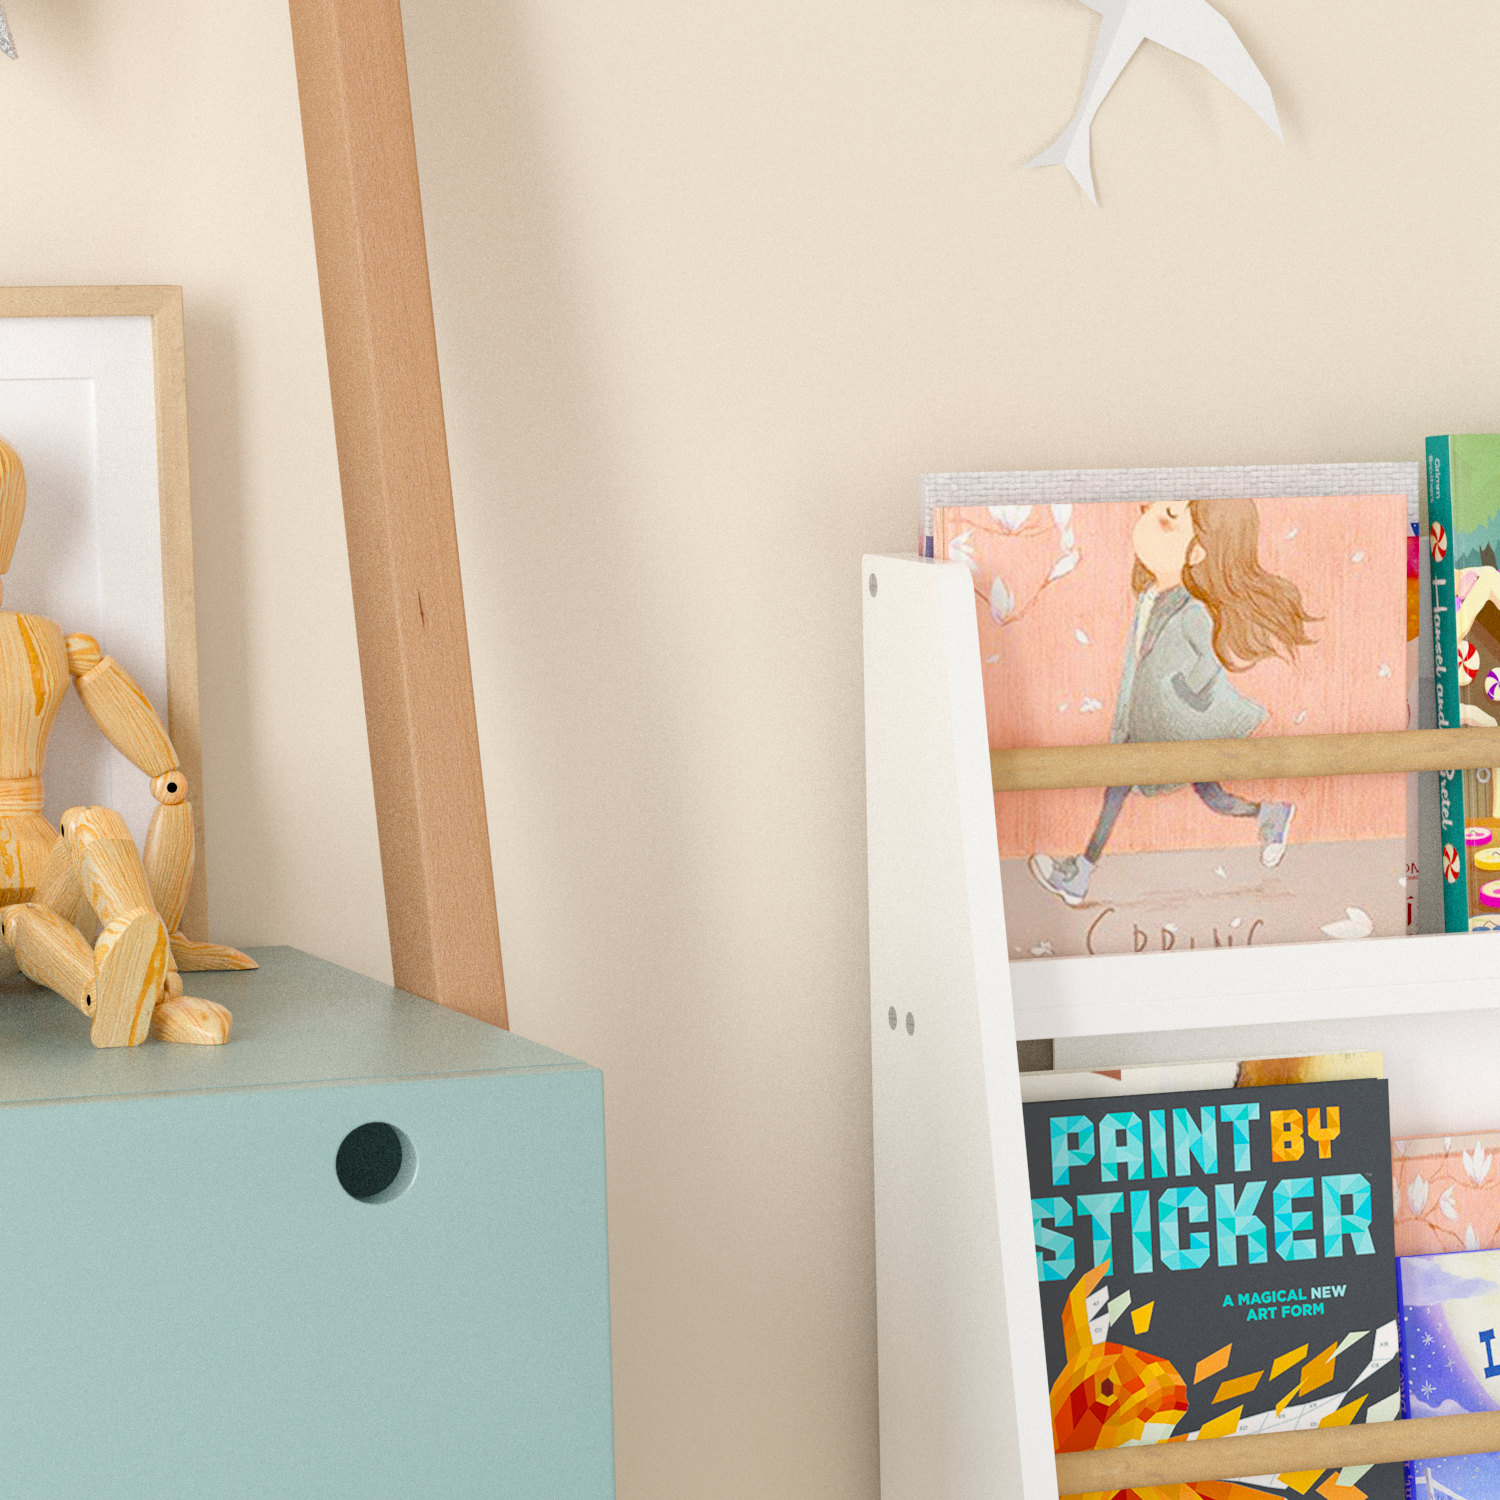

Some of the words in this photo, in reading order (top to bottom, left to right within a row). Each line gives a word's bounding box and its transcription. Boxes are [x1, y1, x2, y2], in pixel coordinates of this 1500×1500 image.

[1432, 577, 1449, 678] Hansel
[1049, 1102, 1260, 1186] PAINT
[1270, 1106, 1341, 1163] BY
[1031, 1173, 1376, 1282] STICKER
[1222, 1294, 1234, 1307] A
[1238, 1288, 1307, 1306] MAGICAL
[1310, 1284, 1347, 1300] NEW
[1246, 1307, 1278, 1321] ART
[1281, 1302, 1325, 1318] FORM
